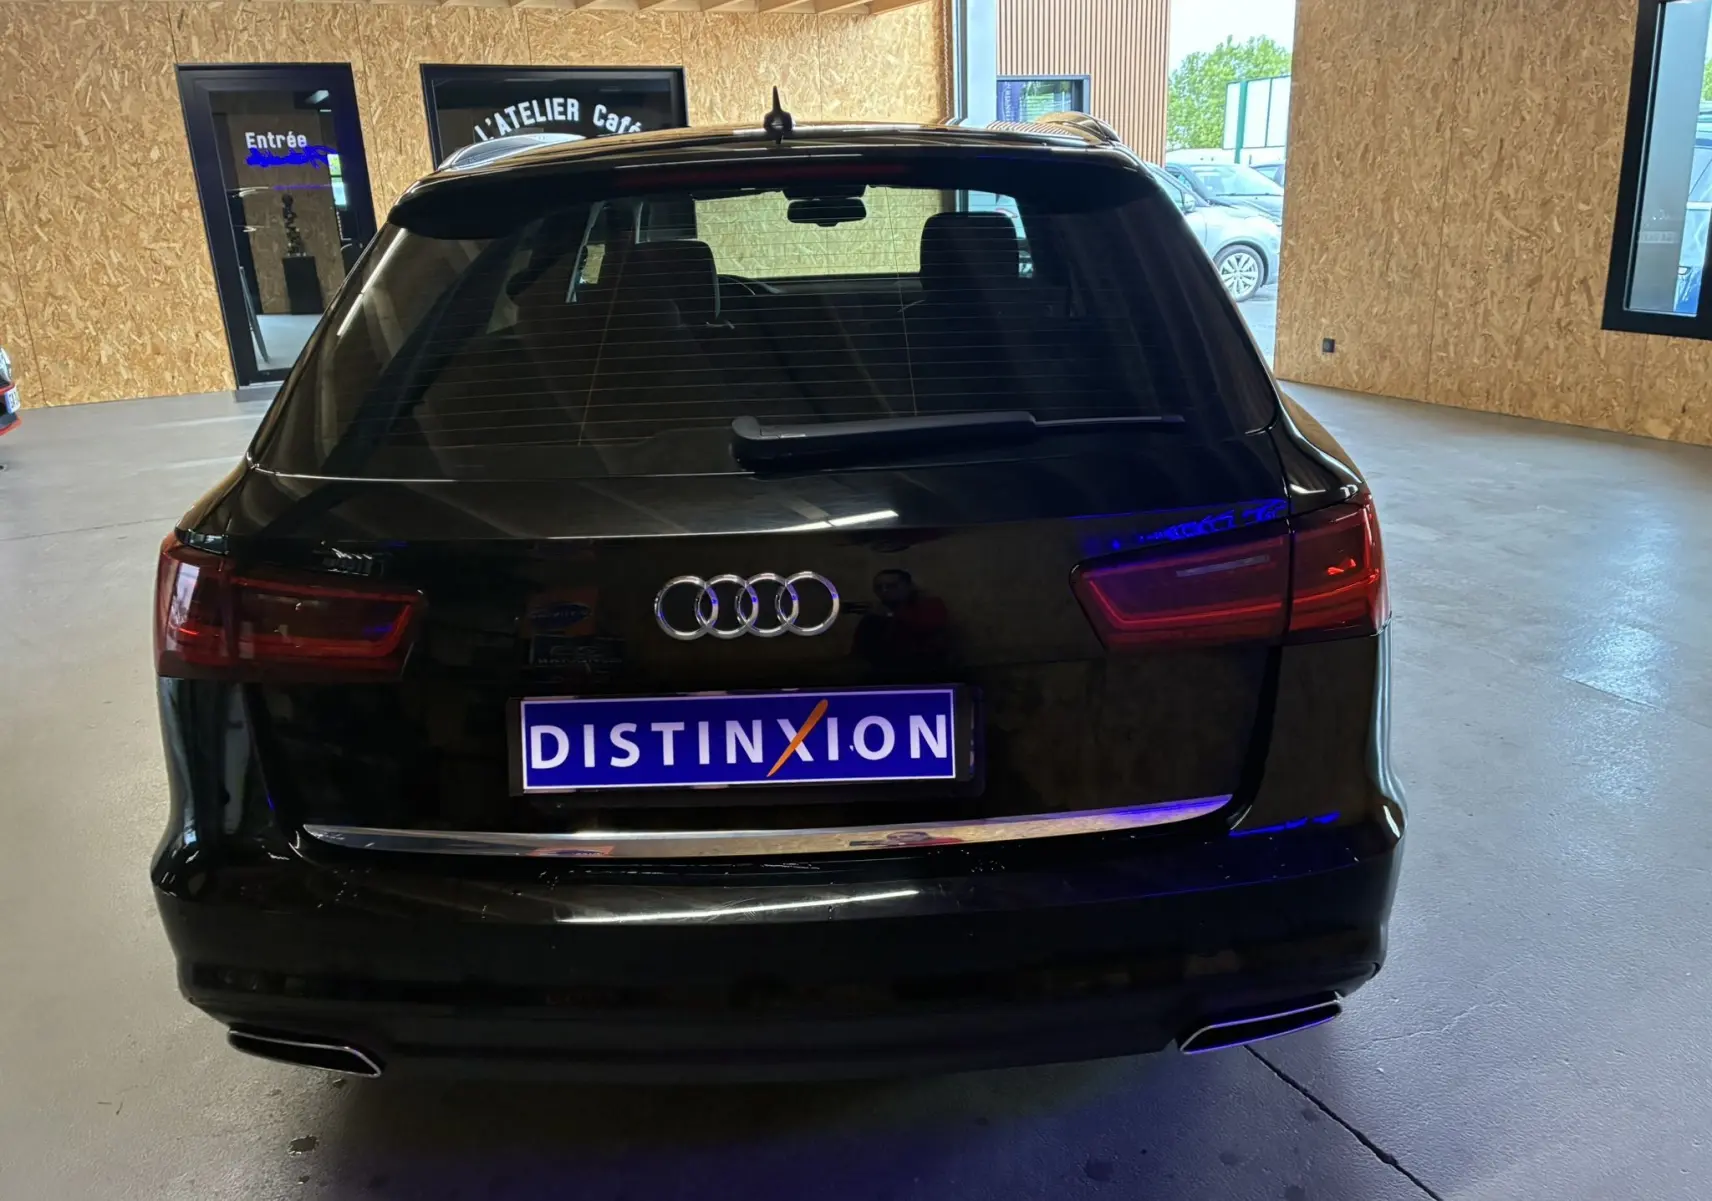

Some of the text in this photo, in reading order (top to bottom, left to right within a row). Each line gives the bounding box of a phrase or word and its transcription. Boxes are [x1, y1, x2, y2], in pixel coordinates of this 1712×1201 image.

[245, 131, 307, 149] Entrée
[474, 98, 580, 141] L'ATELIER
[529, 699, 948, 777] DISTINXION
